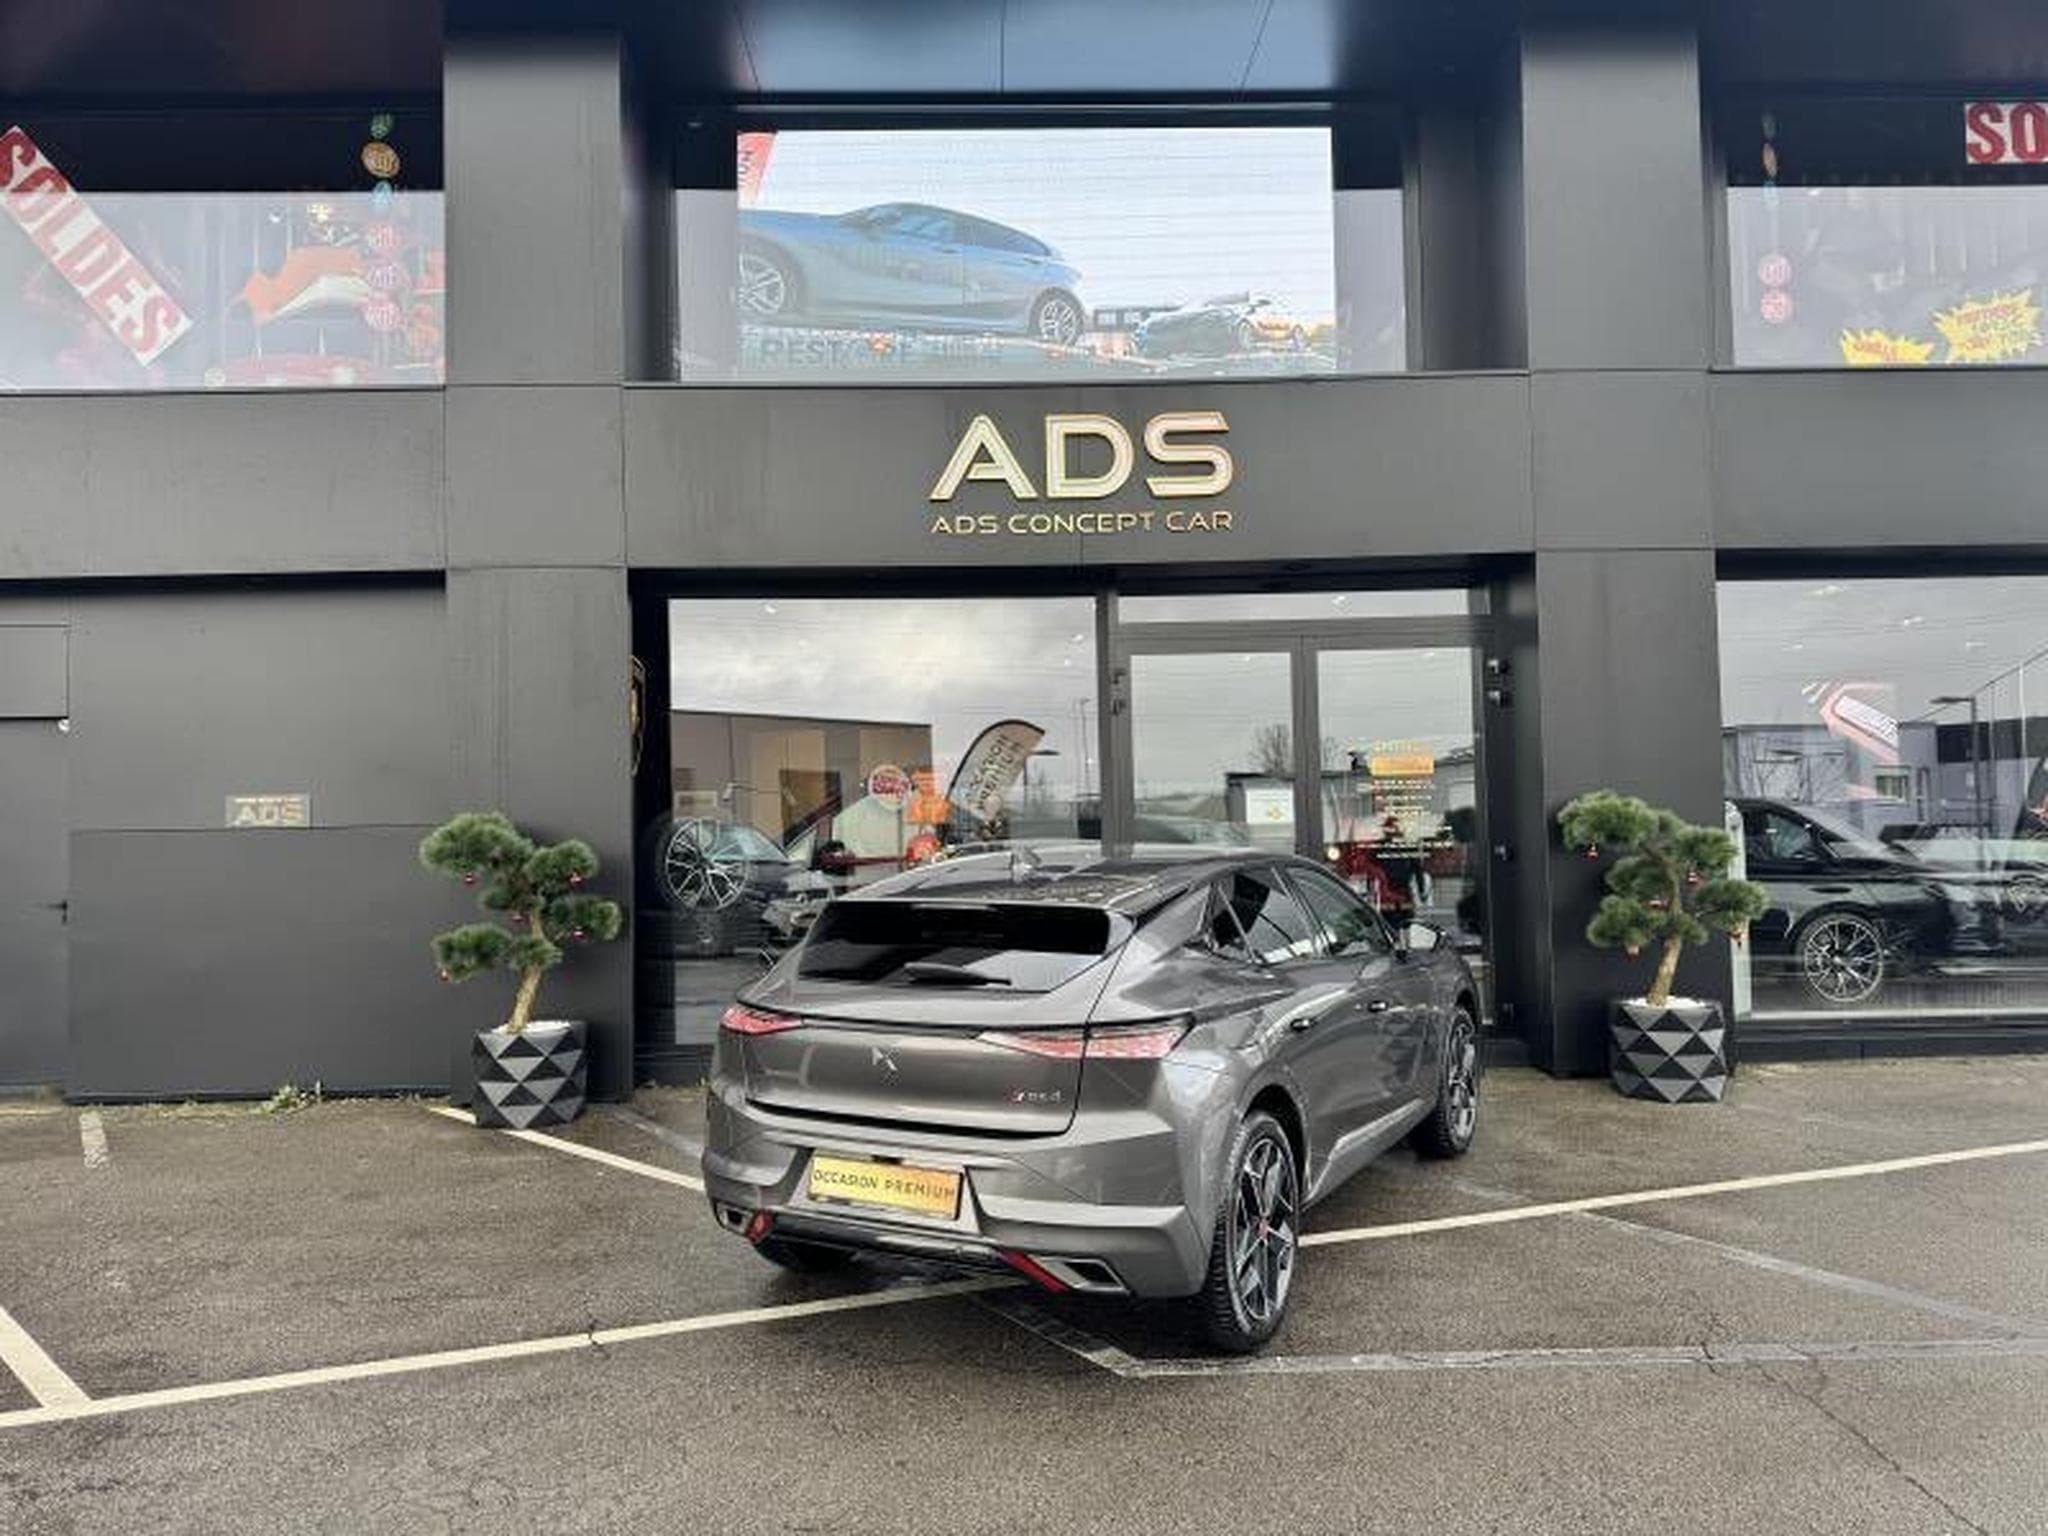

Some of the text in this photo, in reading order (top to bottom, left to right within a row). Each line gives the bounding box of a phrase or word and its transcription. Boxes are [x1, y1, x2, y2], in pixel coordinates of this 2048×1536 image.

[0, 131, 181, 353] SOLDES
[929, 411, 1233, 501] ADS
[930, 510, 1233, 534] ADS CONCEPT CAR
[813, 1169, 956, 1199] OCCASION PREMIUM
